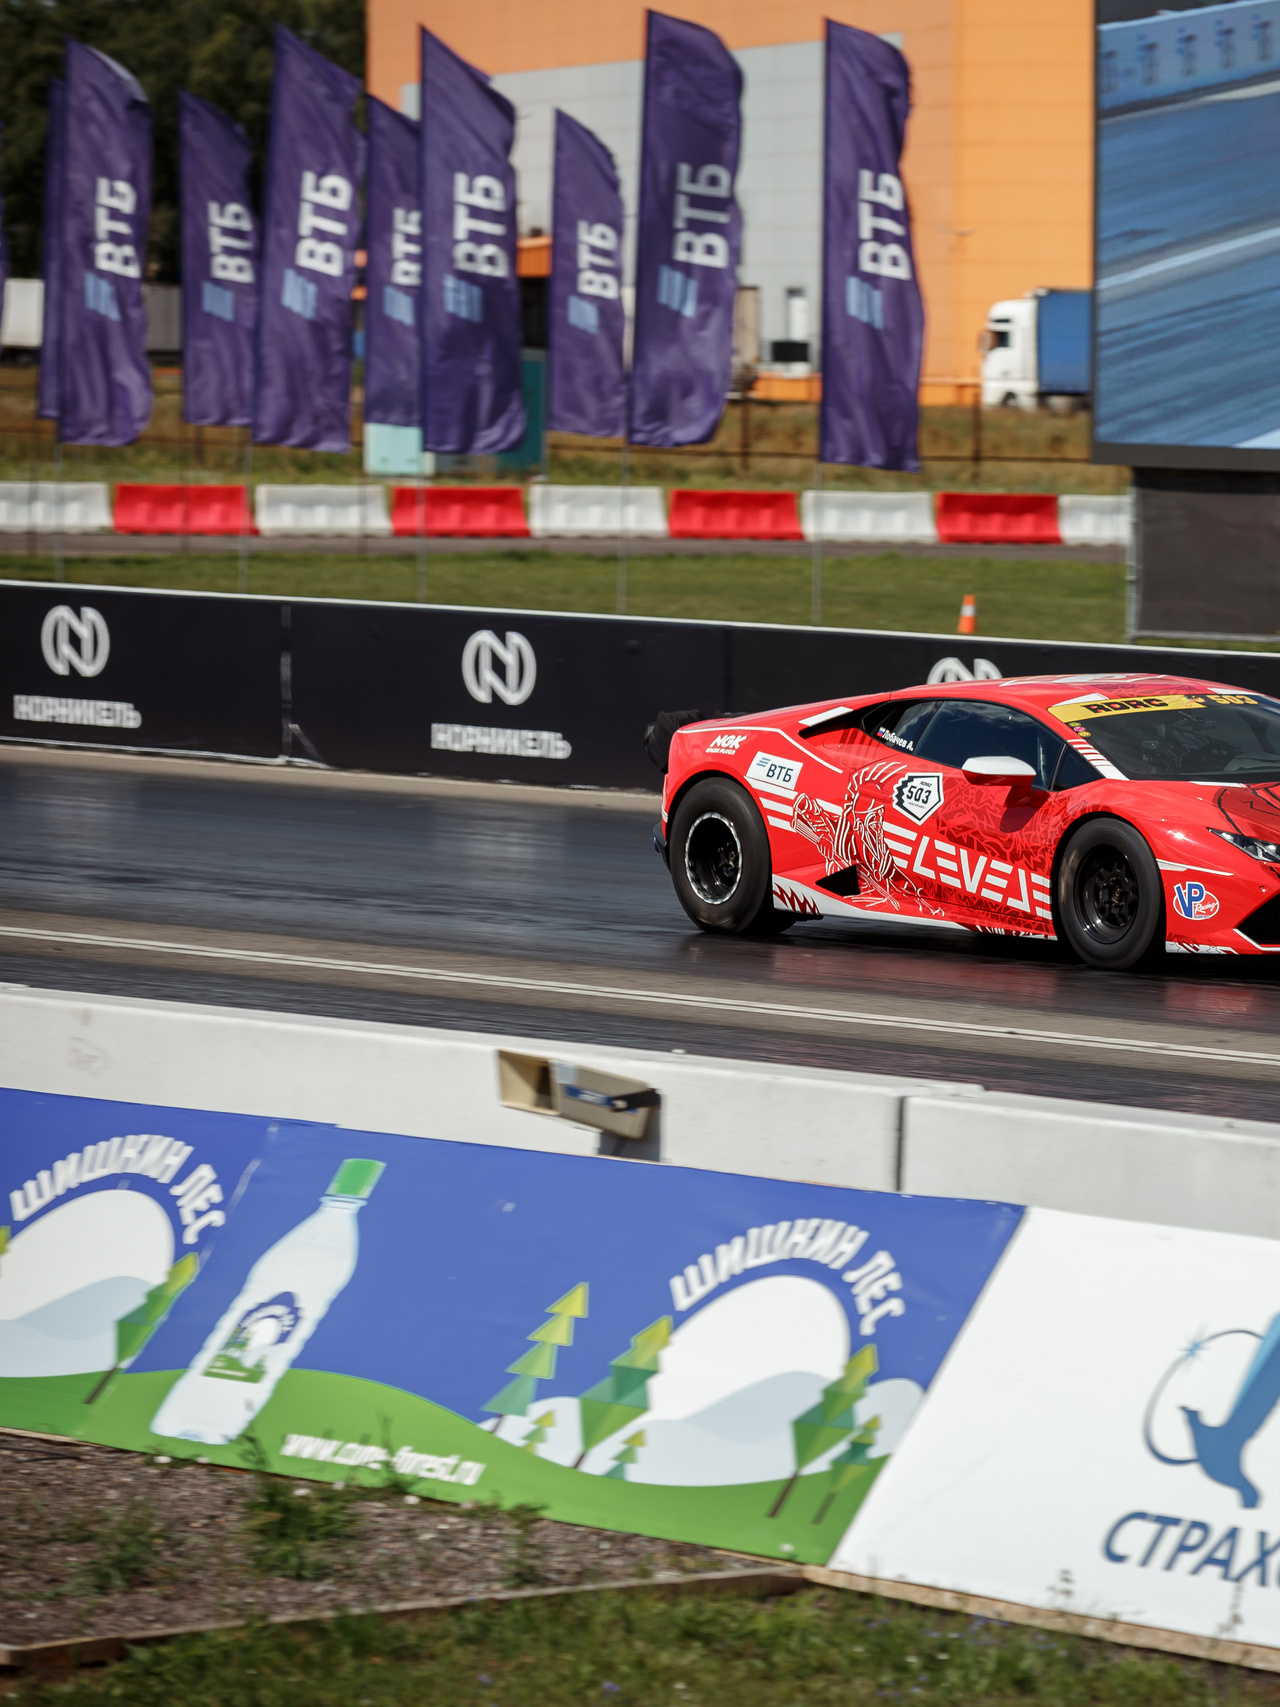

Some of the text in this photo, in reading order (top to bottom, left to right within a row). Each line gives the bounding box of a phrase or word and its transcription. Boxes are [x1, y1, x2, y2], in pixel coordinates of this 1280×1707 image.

[94, 177, 141, 279] ВТБ
[207, 201, 255, 284] ВТБ
[295, 170, 352, 277] ВТБ
[453, 173, 510, 277] ВТБ
[673, 162, 732, 269] ВТБ
[857, 169, 912, 280] ВТБ
[577, 220, 619, 300] ВТБ
[1082, 697, 1169, 714] RDRC
[1206, 694, 1259, 705] 503
[709, 734, 747, 750] NGK
[766, 763, 794, 783] ВТБ
[906, 785, 932, 805] 503
[1174, 881, 1206, 919] VP
[9, 1134, 226, 1245] ШИШКИН ЛЕС
[669, 1218, 906, 1336] ШИШКИН ЛЕС
